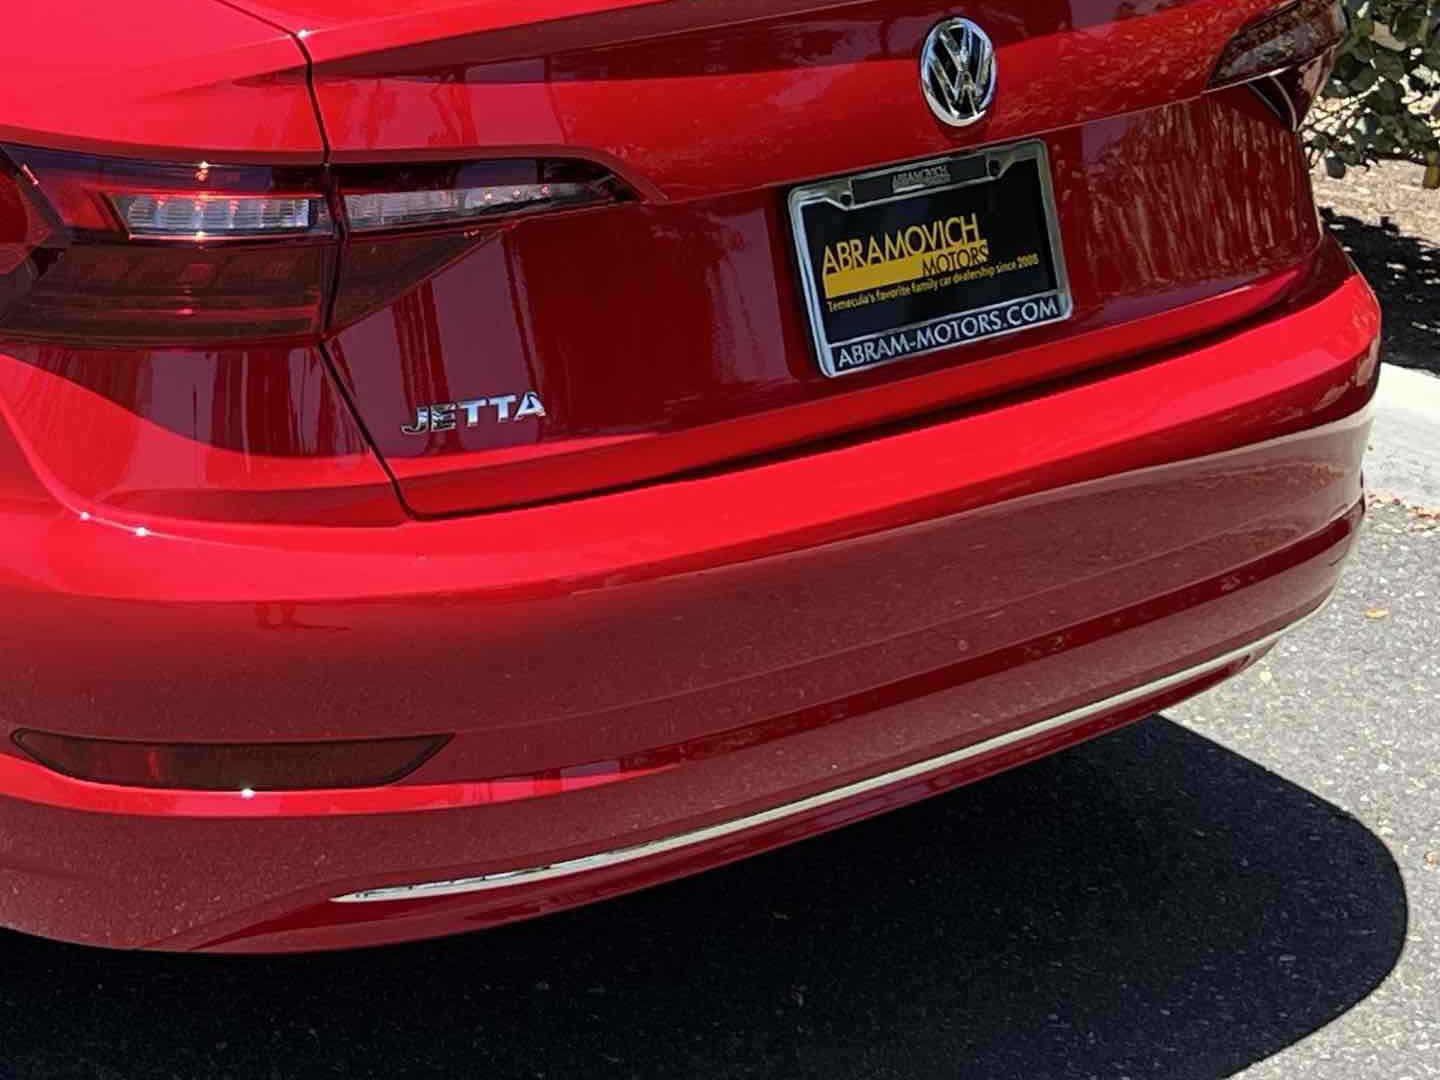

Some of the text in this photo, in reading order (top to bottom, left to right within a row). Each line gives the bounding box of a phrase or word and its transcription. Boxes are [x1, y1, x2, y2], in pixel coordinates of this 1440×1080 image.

[823, 212, 979, 275] ABRAMOVICH
[921, 243, 989, 277] MOTORS
[876, 286, 911, 302] favorite
[911, 277, 939, 292] family
[940, 275, 953, 287] car
[995, 261, 1017, 273] since
[838, 296, 1059, 367] ABRAM-MOTORS.COM
[401, 391, 546, 435] JETTA
